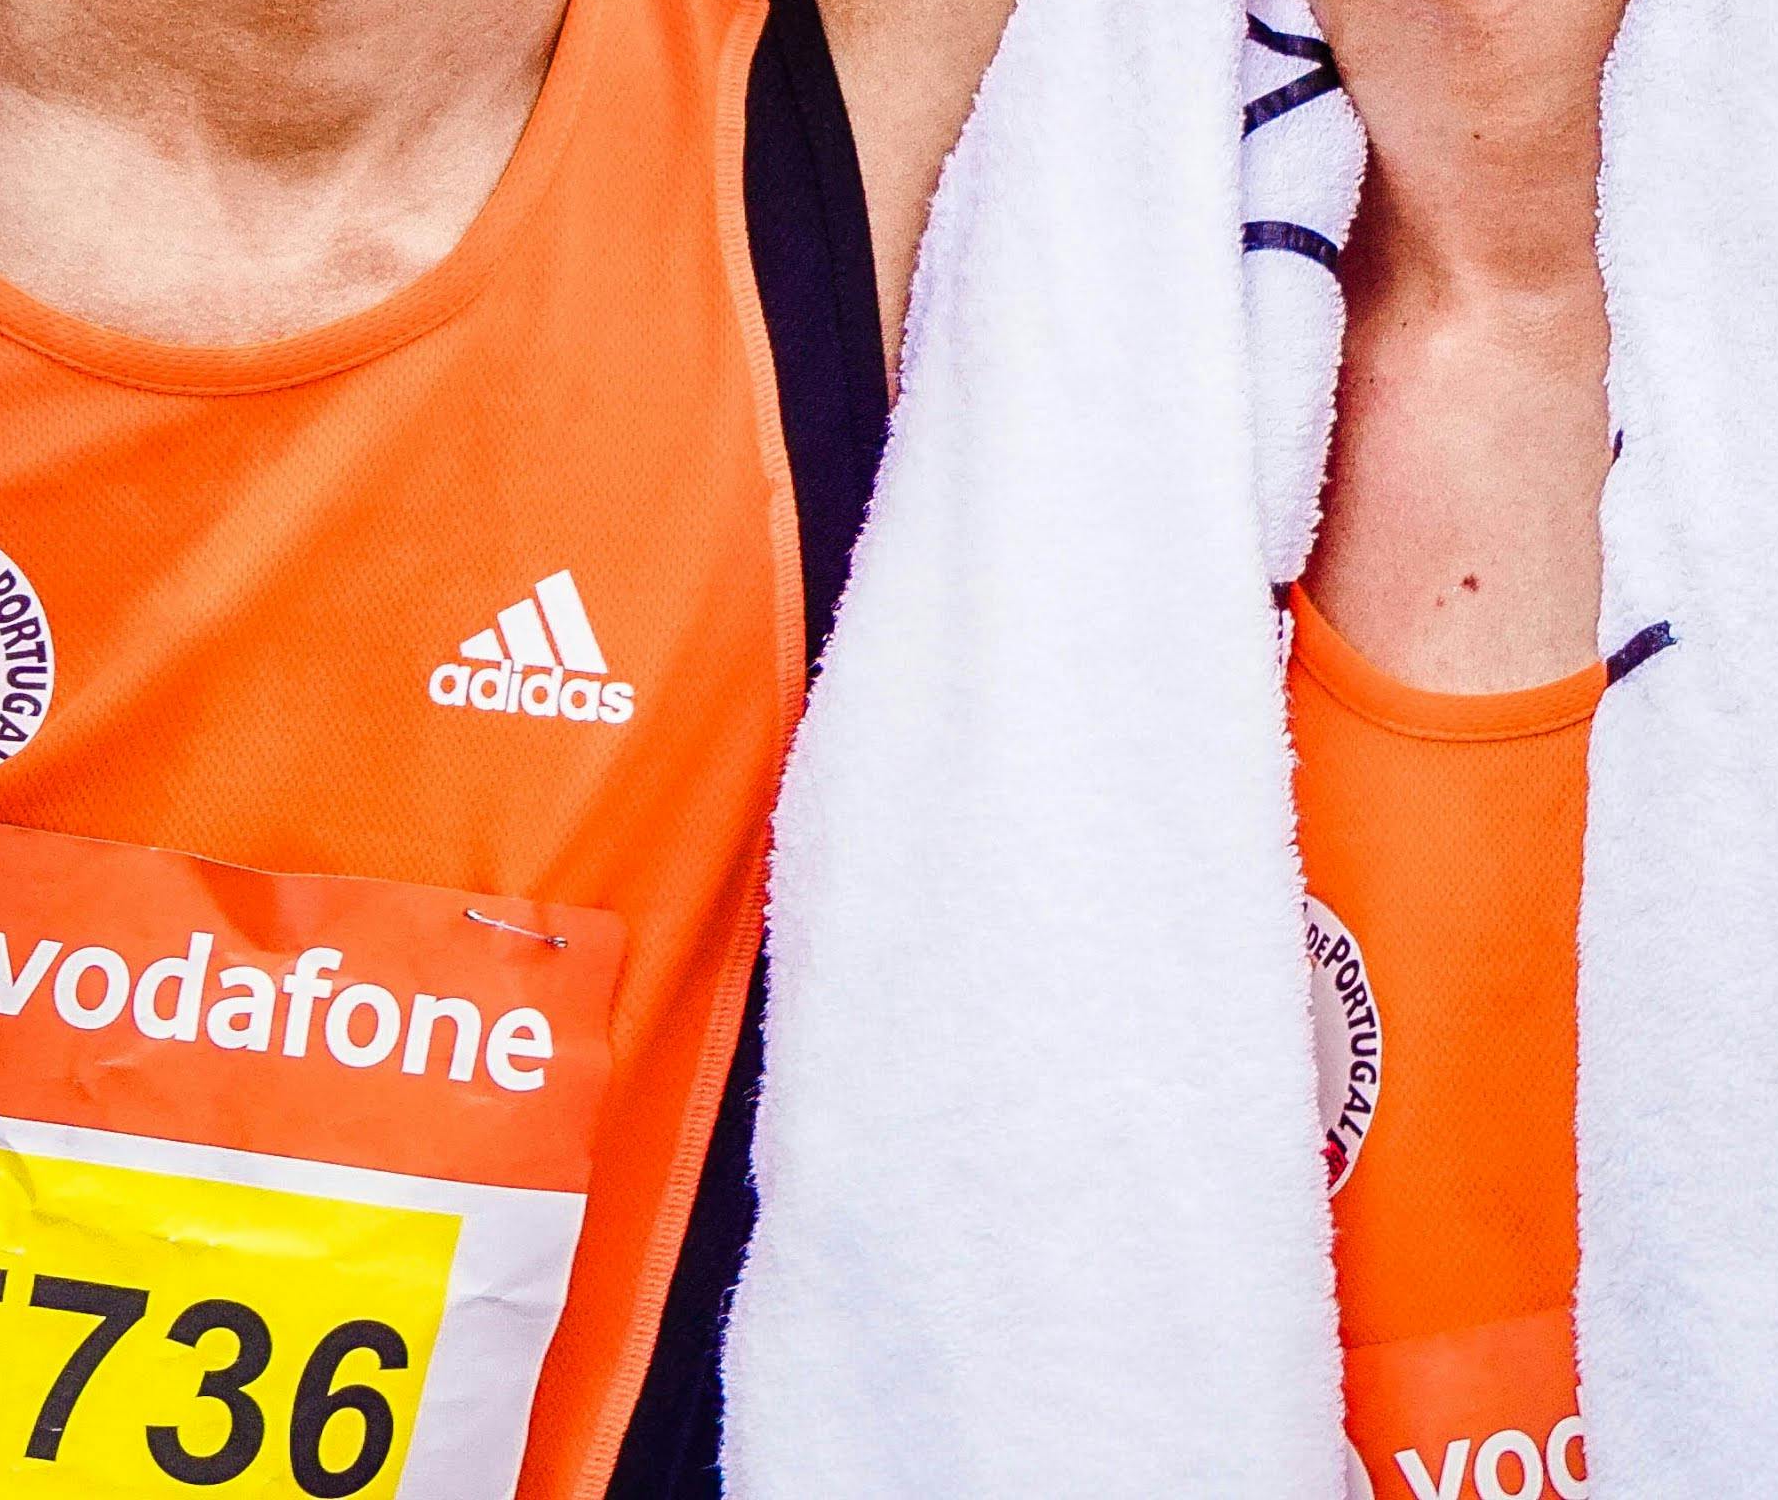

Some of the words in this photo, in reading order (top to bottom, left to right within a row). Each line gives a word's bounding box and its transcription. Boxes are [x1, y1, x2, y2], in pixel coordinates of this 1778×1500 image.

[427, 658, 635, 725] adidas
[1306, 922, 1331, 962] DE
[1322, 933, 1378, 1139] PORTUGAL
